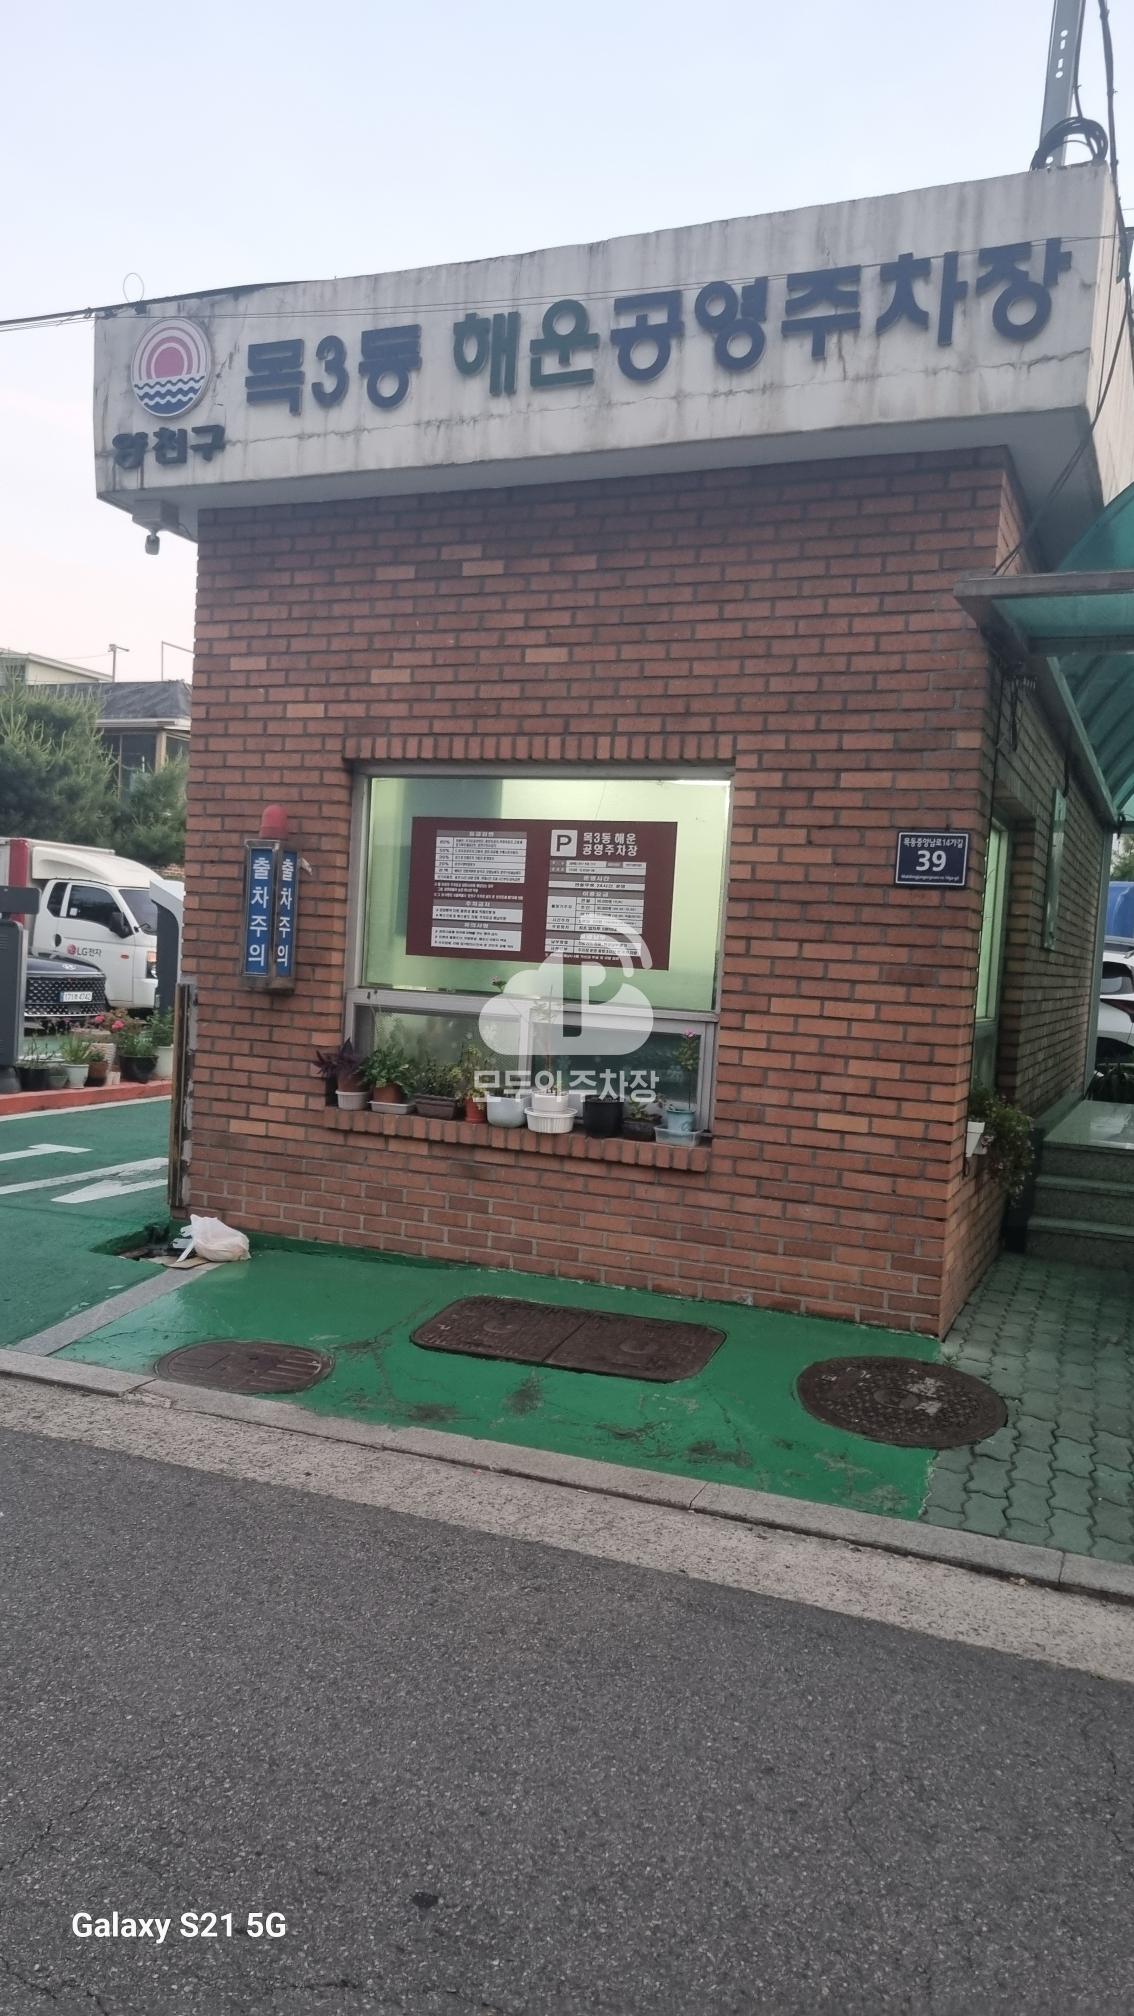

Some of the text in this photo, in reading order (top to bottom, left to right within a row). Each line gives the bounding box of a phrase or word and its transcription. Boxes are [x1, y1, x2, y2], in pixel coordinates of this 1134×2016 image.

[244, 323, 422, 416] 목3동
[556, 835, 572, 852] P
[583, 832, 637, 844] 목3동 해운
[583, 845, 638, 857] 공영주차장
[915, 850, 947, 872] 39
[247, 858, 270, 967] 출차주의
[277, 859, 293, 967] 출차주의
